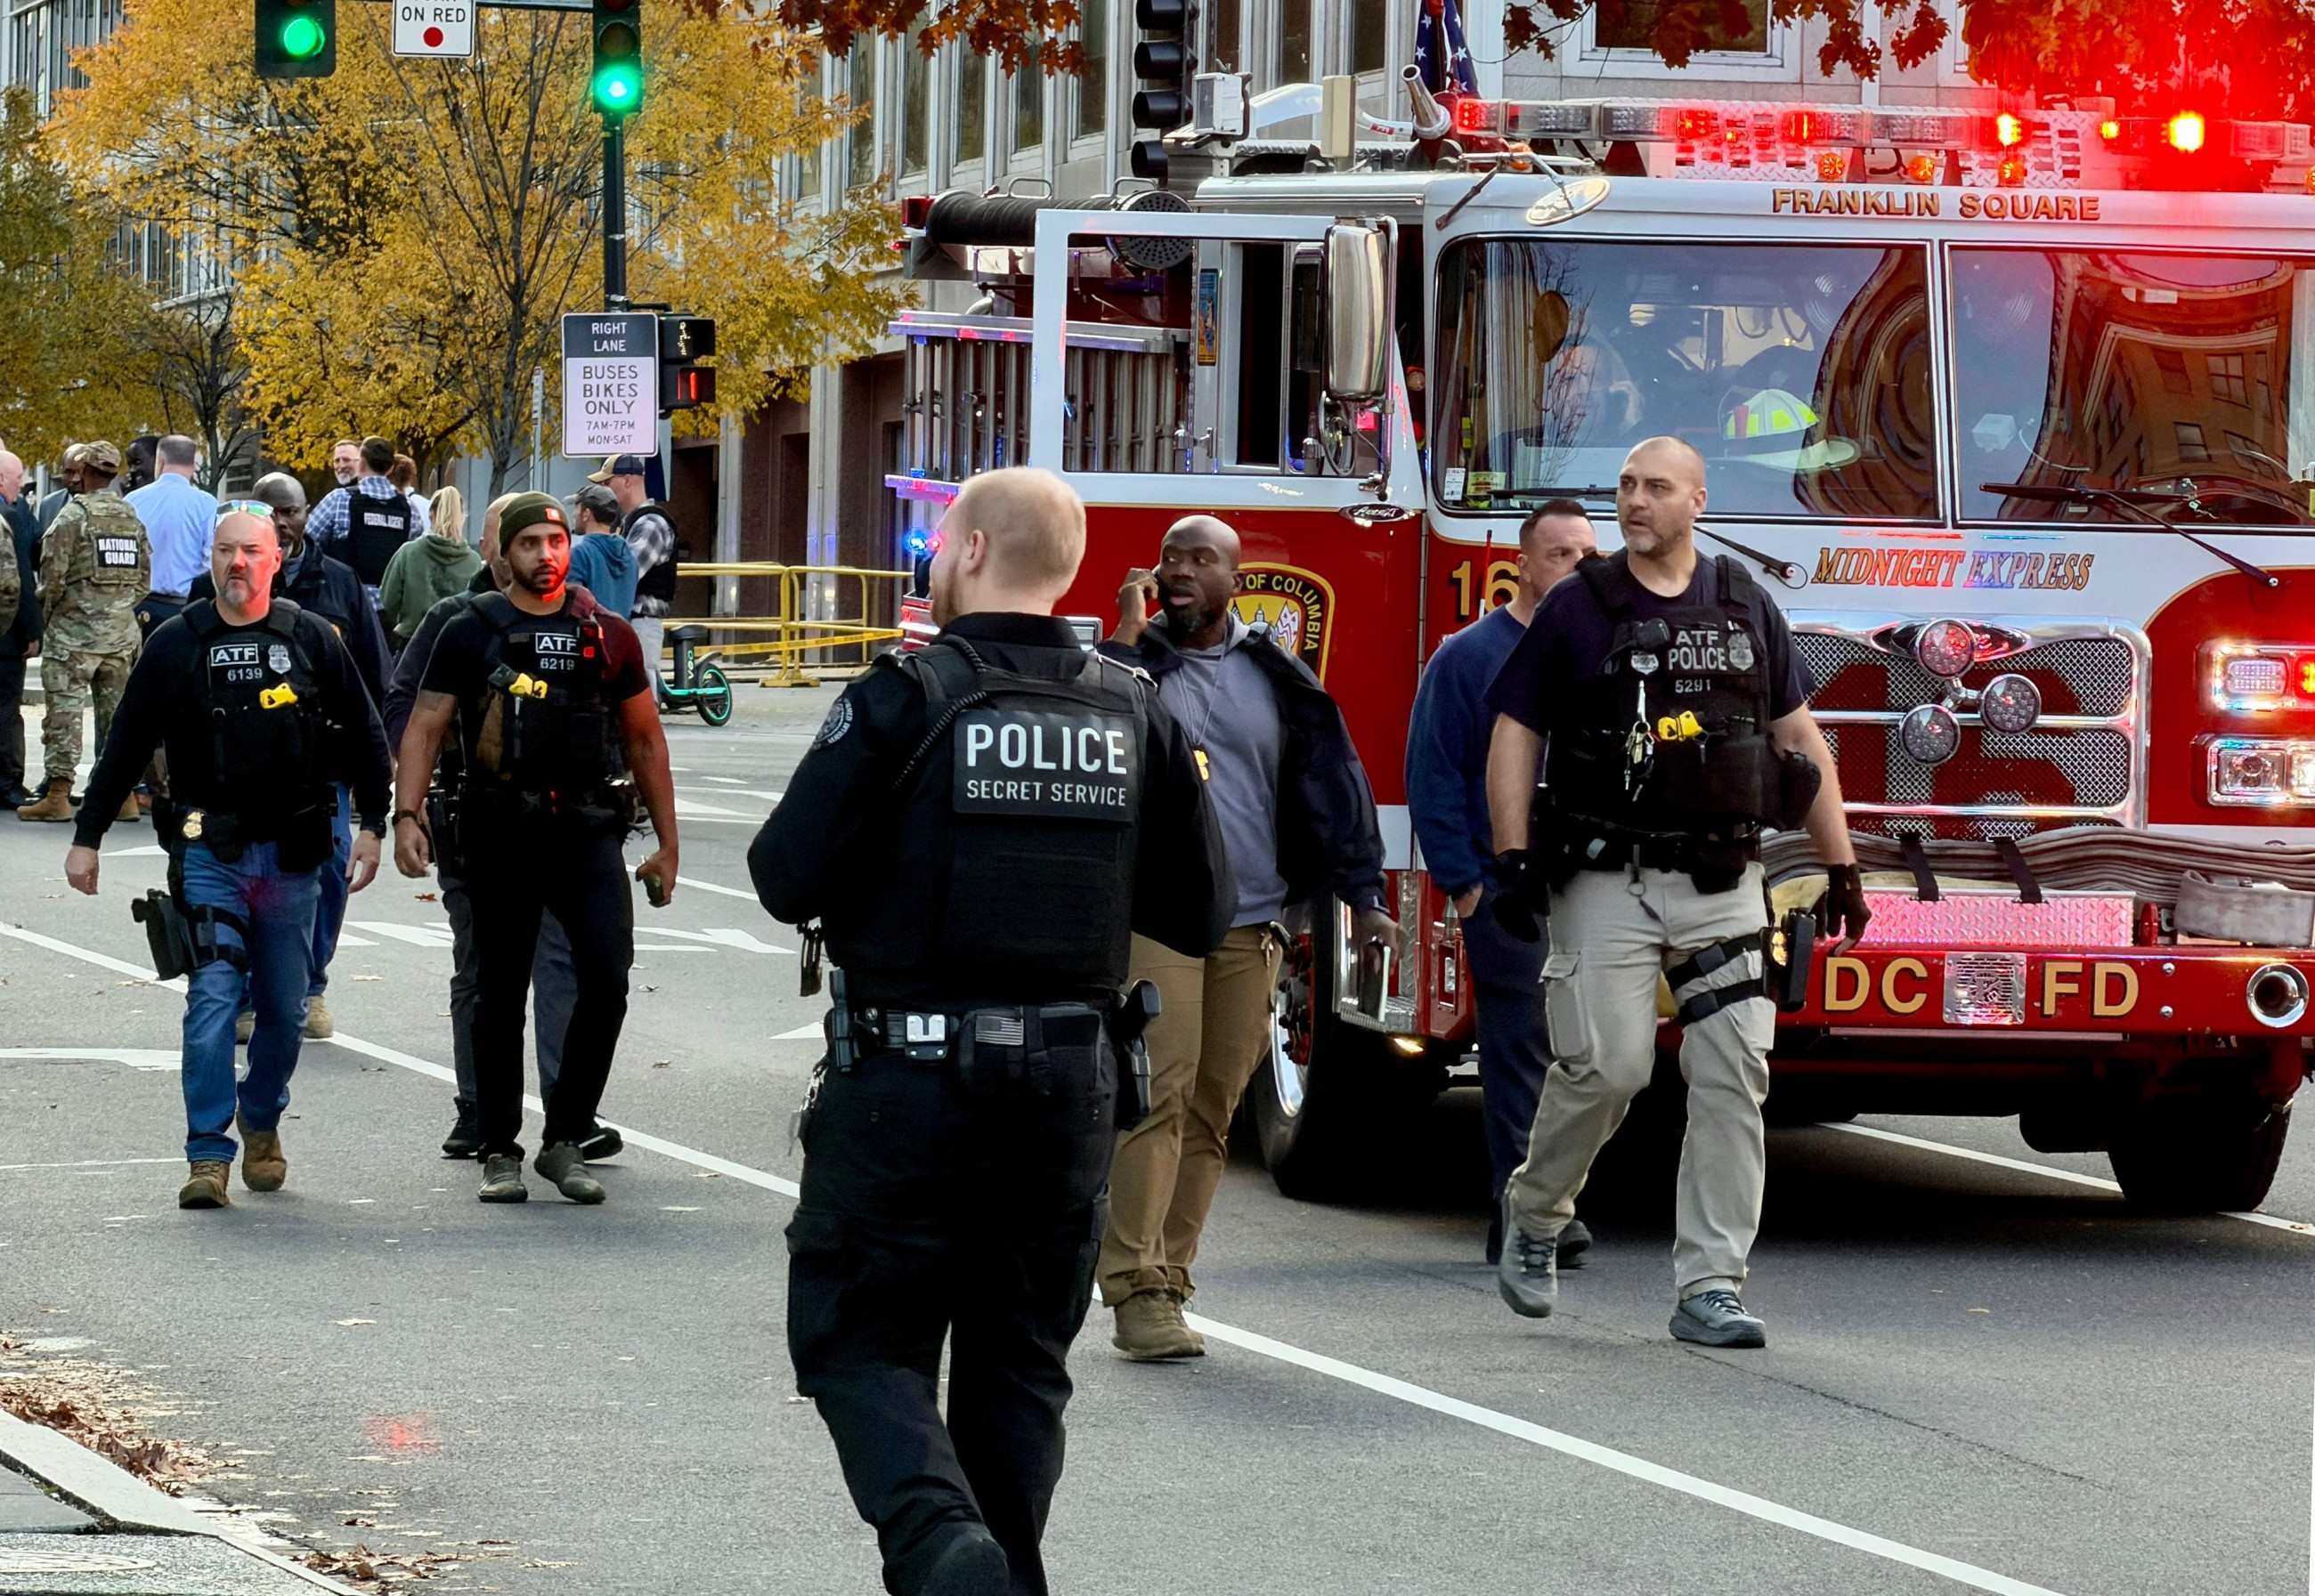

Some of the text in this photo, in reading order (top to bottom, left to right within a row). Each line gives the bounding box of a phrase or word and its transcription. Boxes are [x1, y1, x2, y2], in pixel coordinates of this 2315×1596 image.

[402, 6, 466, 22] ON RED
[1772, 188, 2100, 221] FRANKLIN SQUARE
[591, 321, 627, 335] RIGHT
[593, 340, 627, 352] LANE
[582, 365, 638, 379] BUSES
[582, 383, 638, 398] BIKES
[585, 401, 635, 415] ONLY
[586, 420, 636, 431] 7AM-7PM
[588, 434, 632, 445] MON-SAT
[98, 538, 138, 552] NATIONAL
[105, 552, 135, 565] GUARD
[1811, 547, 2095, 590] MIDNIGHT EXPRESS
[1451, 560, 1521, 616] 16
[1246, 574, 1322, 651] OF COLUMBIA
[539, 636, 578, 652] ATF
[1676, 630, 1718, 645] ATF
[215, 647, 256, 663] ATF
[1668, 647, 1727, 671] POLICE
[227, 668, 263, 681] 6139
[1675, 679, 1711, 693] 5291
[967, 723, 1127, 774] POLICE
[966, 779, 1127, 806] SECRET SERVICE
[1825, 957, 2139, 1017] DC FD
